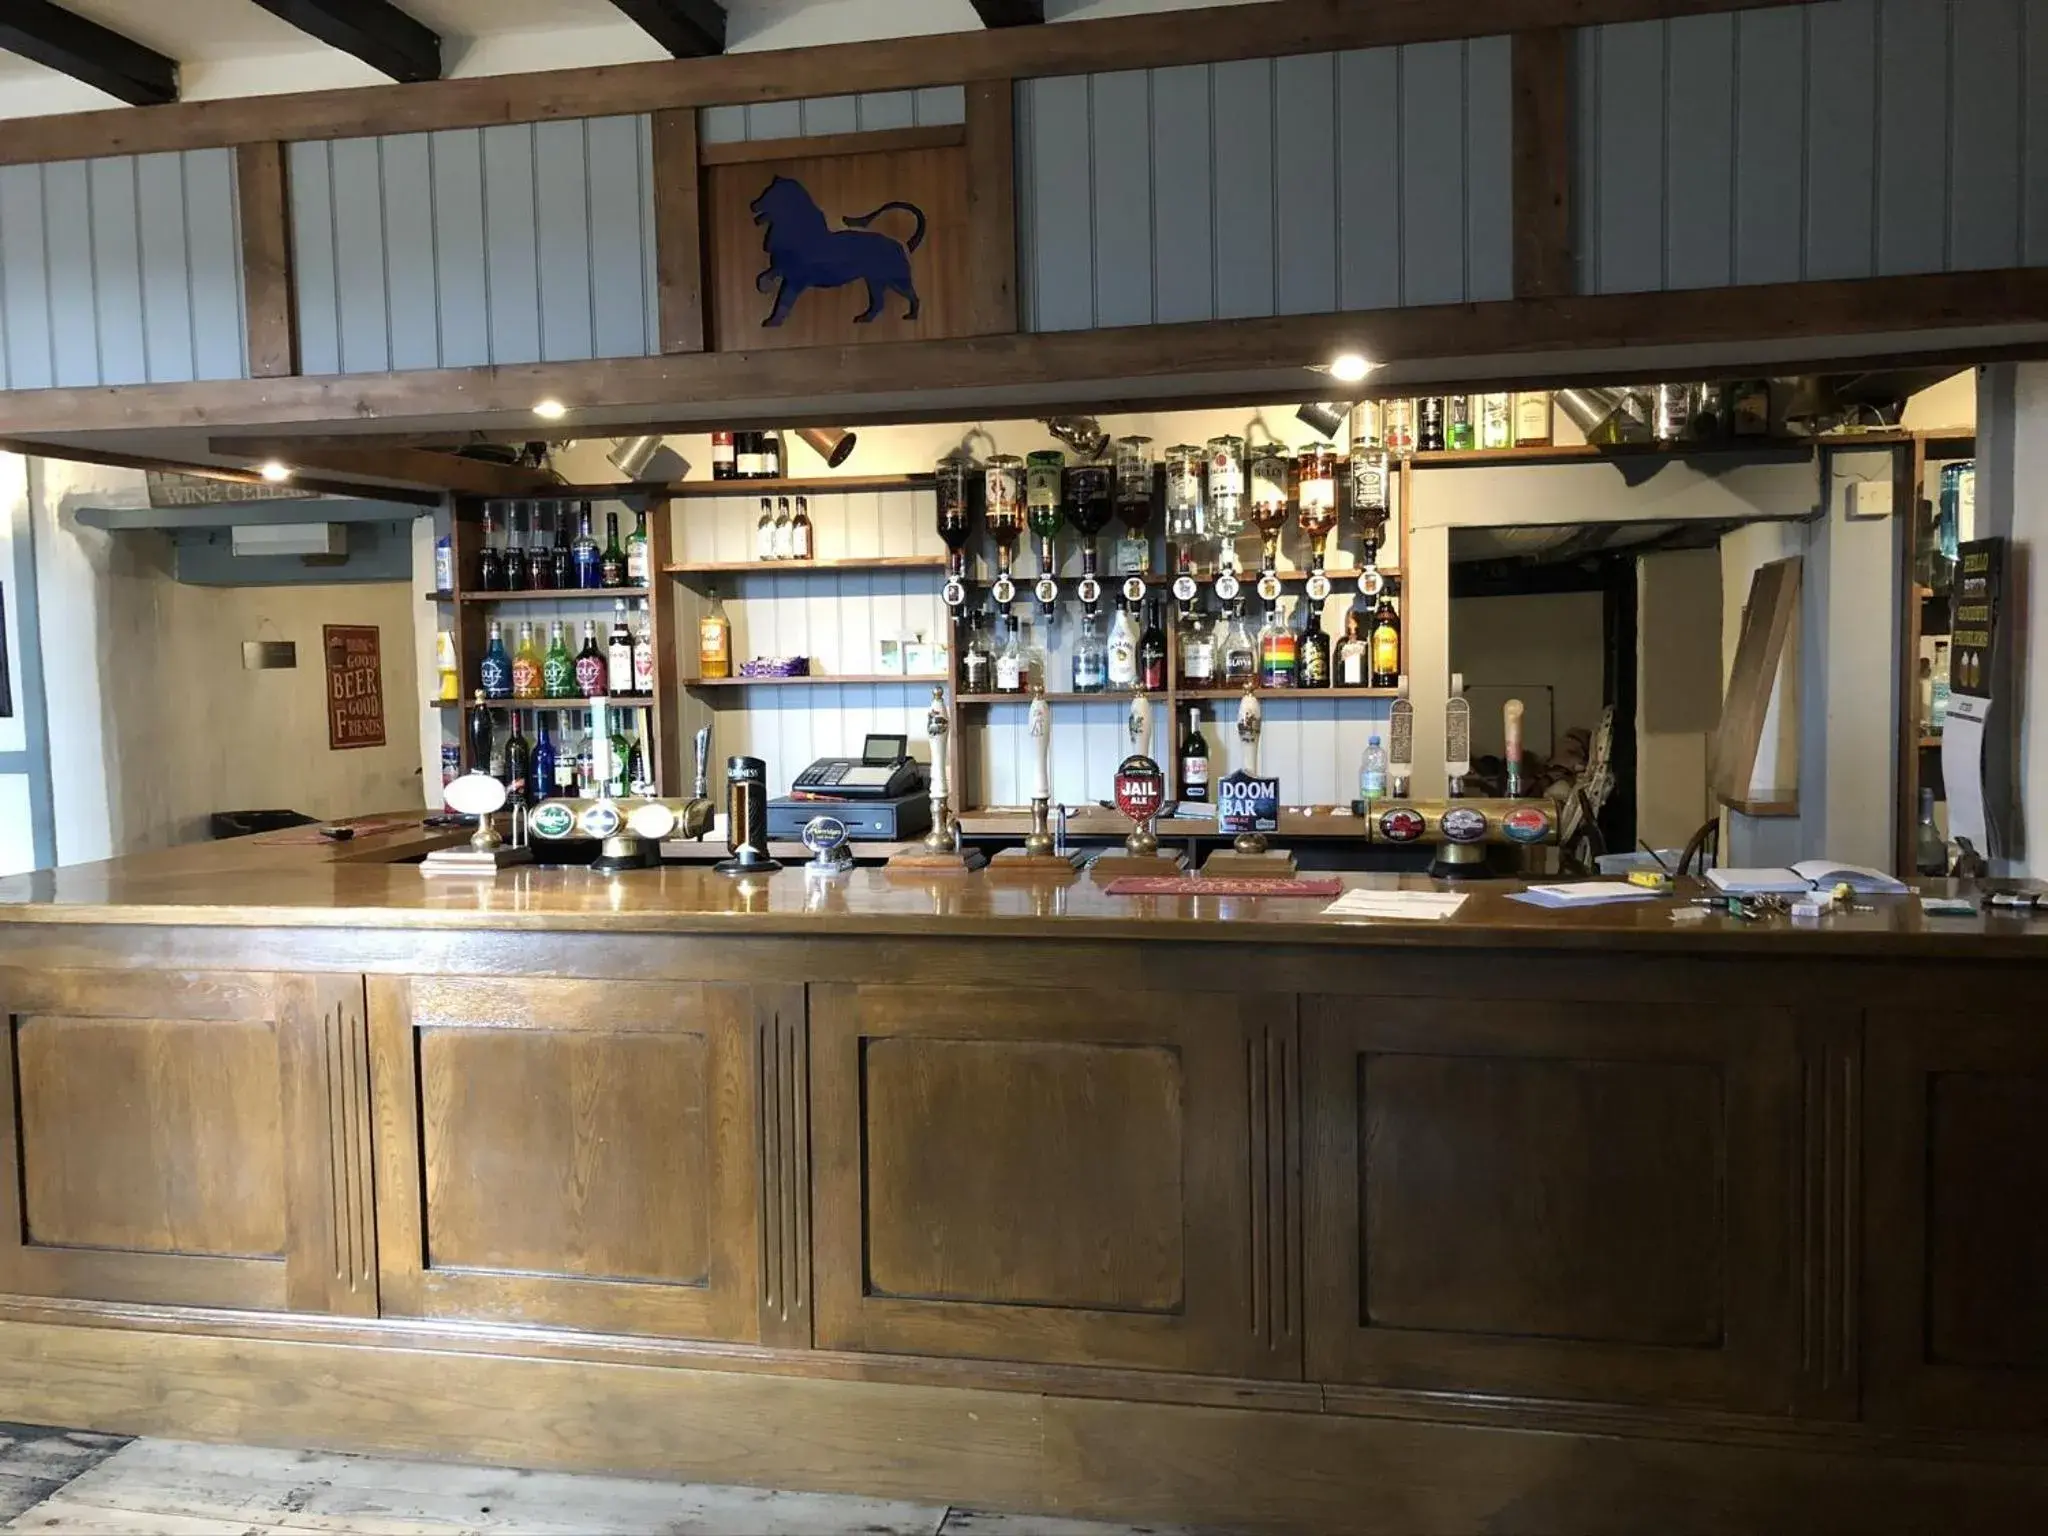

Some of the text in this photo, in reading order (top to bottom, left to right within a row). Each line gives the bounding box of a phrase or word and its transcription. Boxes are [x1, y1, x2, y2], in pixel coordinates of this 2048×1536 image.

[164, 484, 221, 504] WINE
[347, 655, 377, 668] GOOD
[332, 668, 377, 699] BEER
[348, 695, 378, 716] GOOD
[1121, 781, 1157, 796] JAIL
[1222, 781, 1275, 799] DOOM
[1131, 796, 1148, 805] ALE
[1223, 799, 1257, 816] BAR
